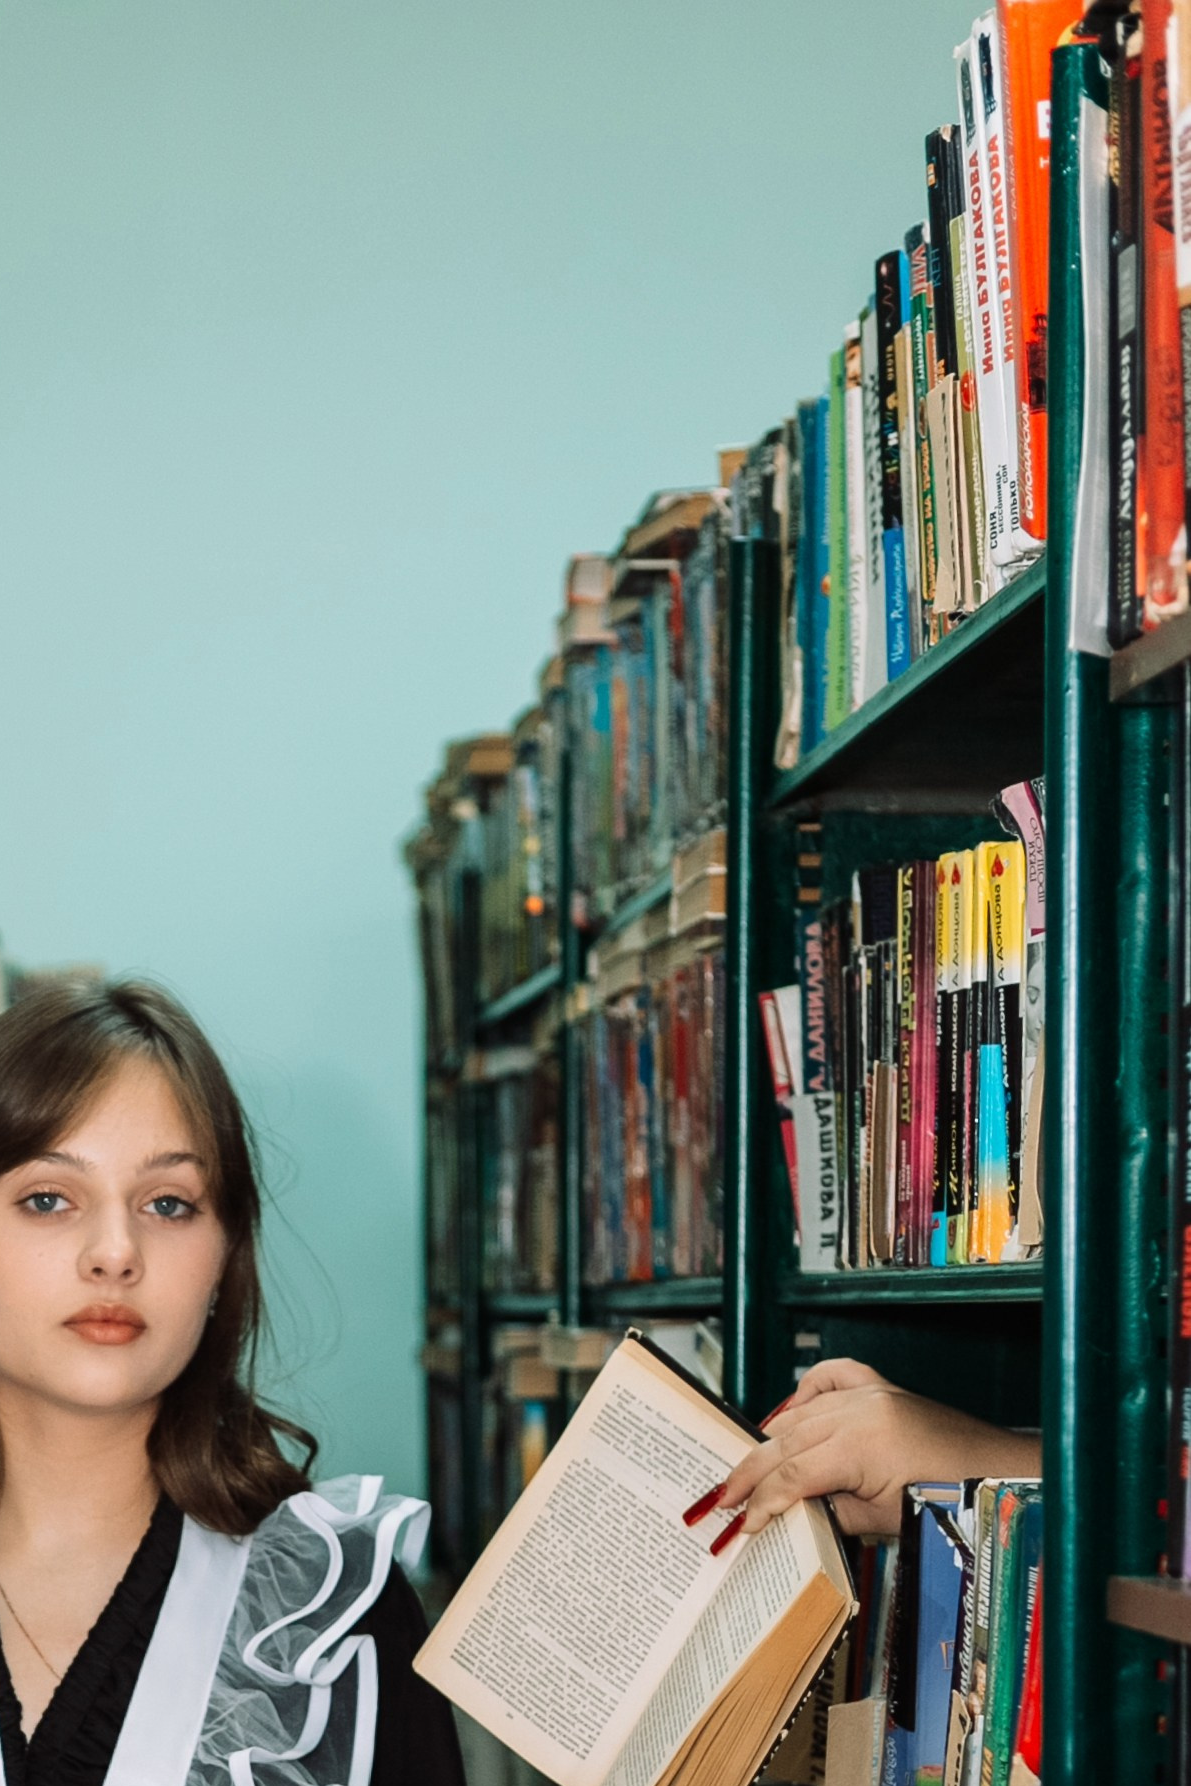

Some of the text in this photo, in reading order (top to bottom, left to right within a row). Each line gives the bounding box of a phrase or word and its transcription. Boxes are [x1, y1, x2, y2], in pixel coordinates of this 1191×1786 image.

[968, 149, 994, 375] Инна БУЛГАКОВА
[987, 134, 1015, 363] Инна БУЛГАКОВА
[954, 274, 963, 321] ГАЛИНА
[1001, 464, 1009, 484] СОН
[1020, 401, 1034, 520] ВОЛОДАРСКАЯ
[989, 505, 999, 550] СОНЯ,
[995, 464, 1004, 534] БЕССОННИЦА,
[1009, 480, 1020, 533] ТОЛЬКО
[1028, 841, 1037, 882] ГРЕХИ
[804, 921, 825, 1062] ДАНИЛОВА
[813, 1095, 835, 1221] ДАШКОВА
